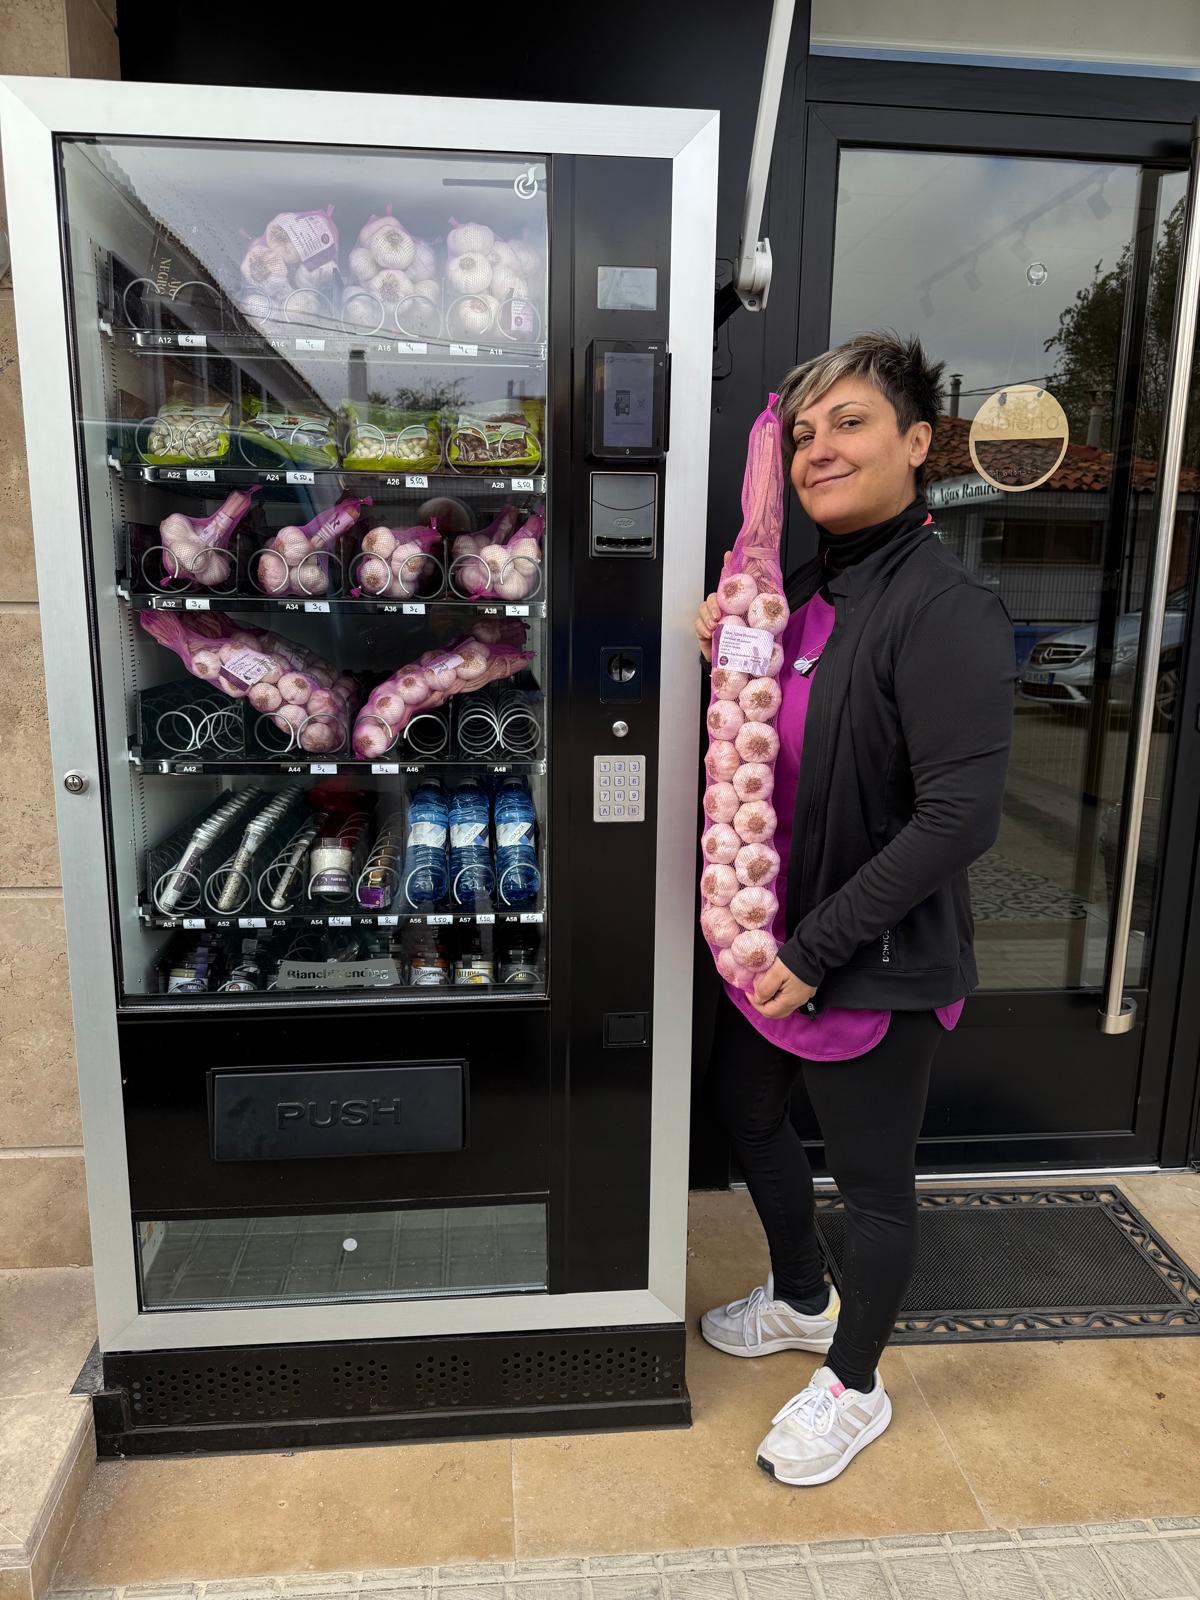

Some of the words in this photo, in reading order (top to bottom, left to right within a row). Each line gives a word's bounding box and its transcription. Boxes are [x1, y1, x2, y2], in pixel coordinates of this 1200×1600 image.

[158, 336, 172, 344] A12
[378, 344, 391, 352] A16
[167, 471, 181, 479] A22
[276, 1098, 401, 1129] PUSH
